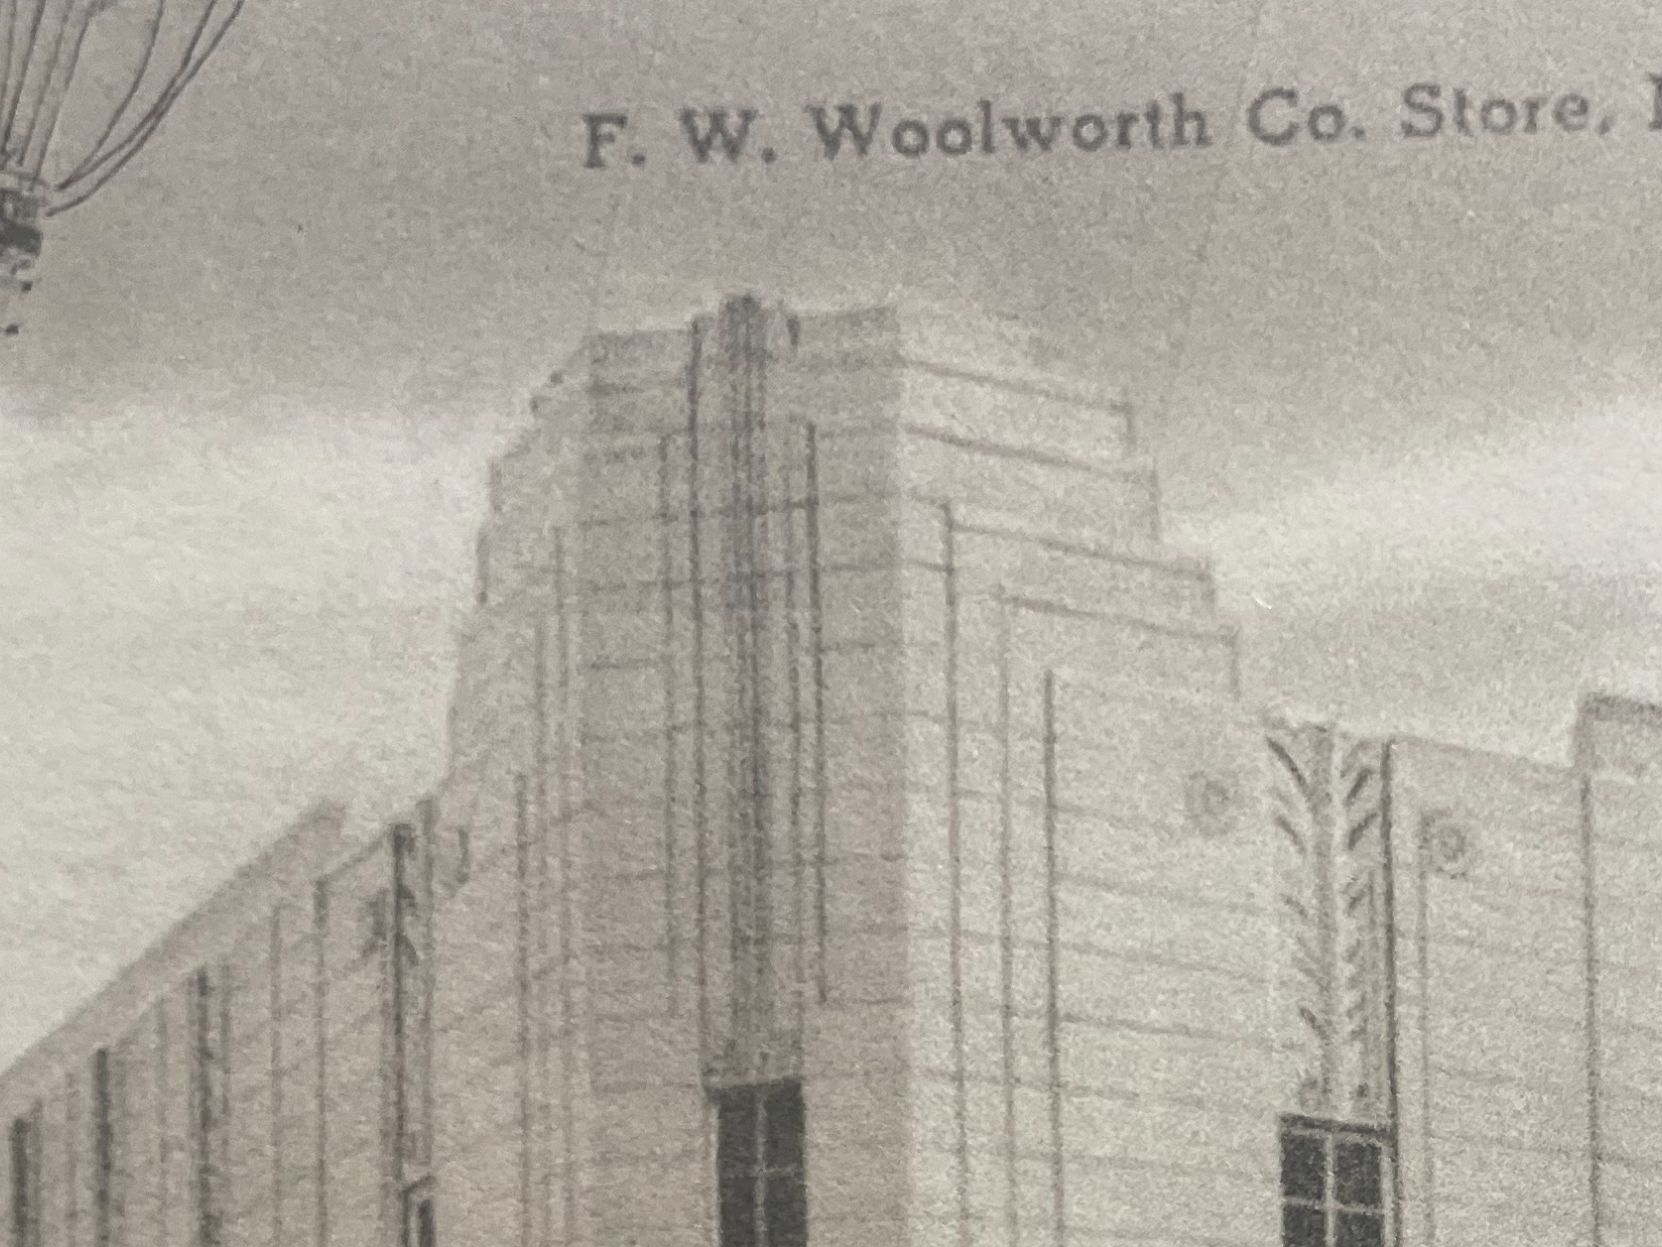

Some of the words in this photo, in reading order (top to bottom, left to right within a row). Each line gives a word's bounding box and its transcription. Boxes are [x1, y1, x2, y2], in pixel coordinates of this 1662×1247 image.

[580, 112, 647, 170] F.
[678, 105, 778, 165] W.
[804, 90, 1213, 162] Woolworth
[1244, 86, 1367, 148] Co.
[1400, 80, 1614, 142] Store,
